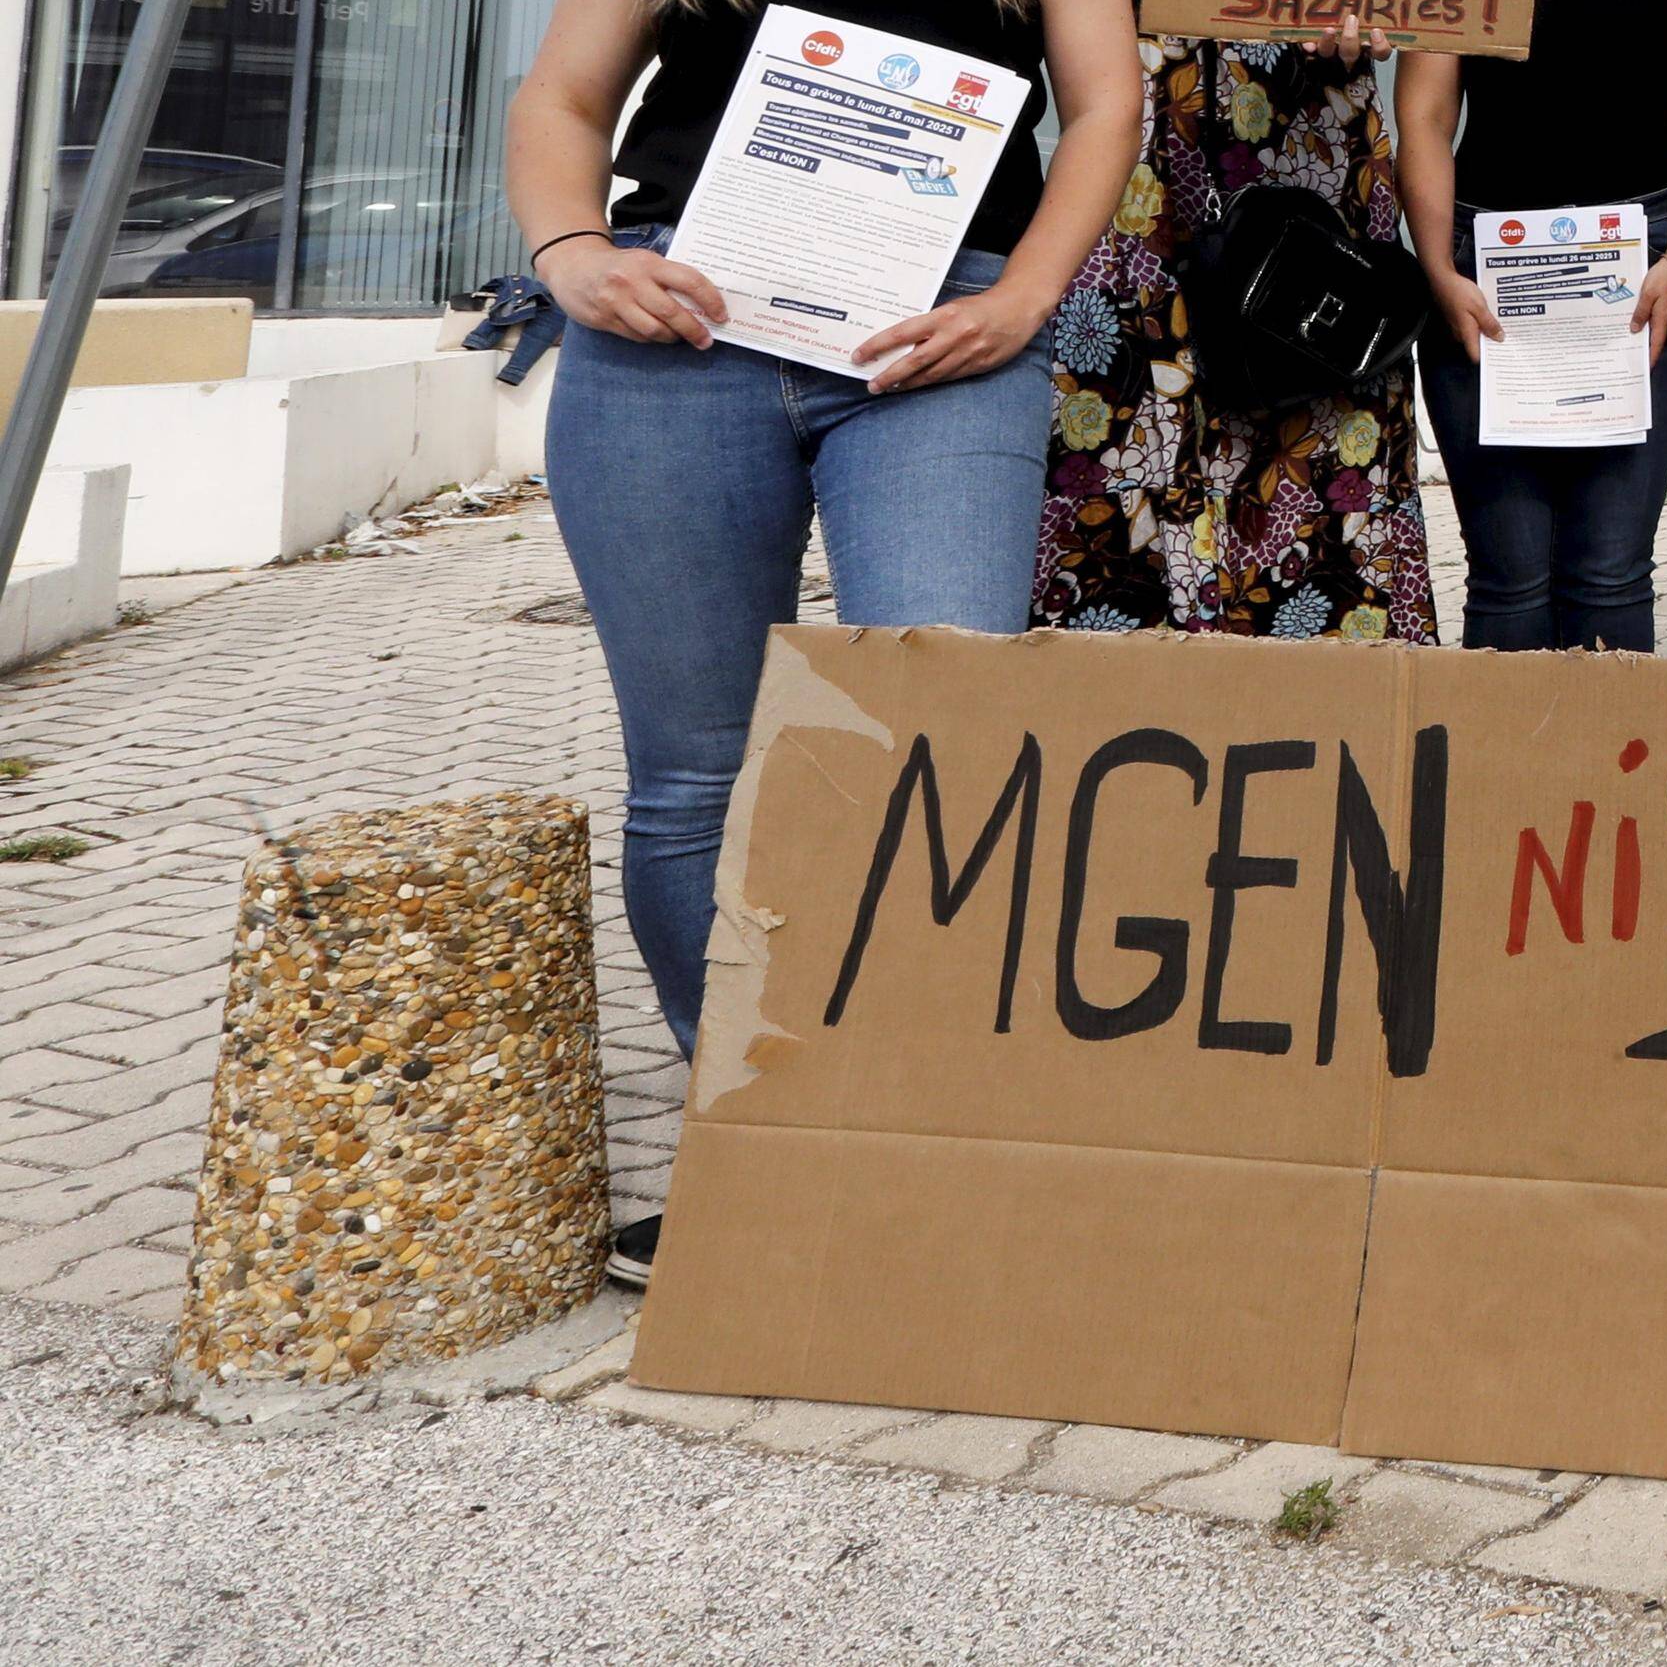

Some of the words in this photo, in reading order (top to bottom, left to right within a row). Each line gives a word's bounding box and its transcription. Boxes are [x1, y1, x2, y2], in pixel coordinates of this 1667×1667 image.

[764, 72, 793, 88] Tous
[793, 82, 808, 93] en
[809, 85, 843, 104] grève
[843, 95, 856, 107] le
[856, 99, 886, 116] lundi
[887, 108, 902, 120] 26
[902, 113, 925, 126] mai
[925, 119, 953, 135] 2025
[946, 86, 985, 115] cgt
[748, 143, 778, 164] C'est
[779, 152, 807, 168] NON
[1601, 227, 1622, 240] cgt
[1518, 257, 1539, 266] grève
[1549, 255, 1568, 263] lundi
[1499, 306, 1519, 315] C'est
[1520, 306, 1538, 314] NON
[823, 724, 1447, 1079] MGEN
